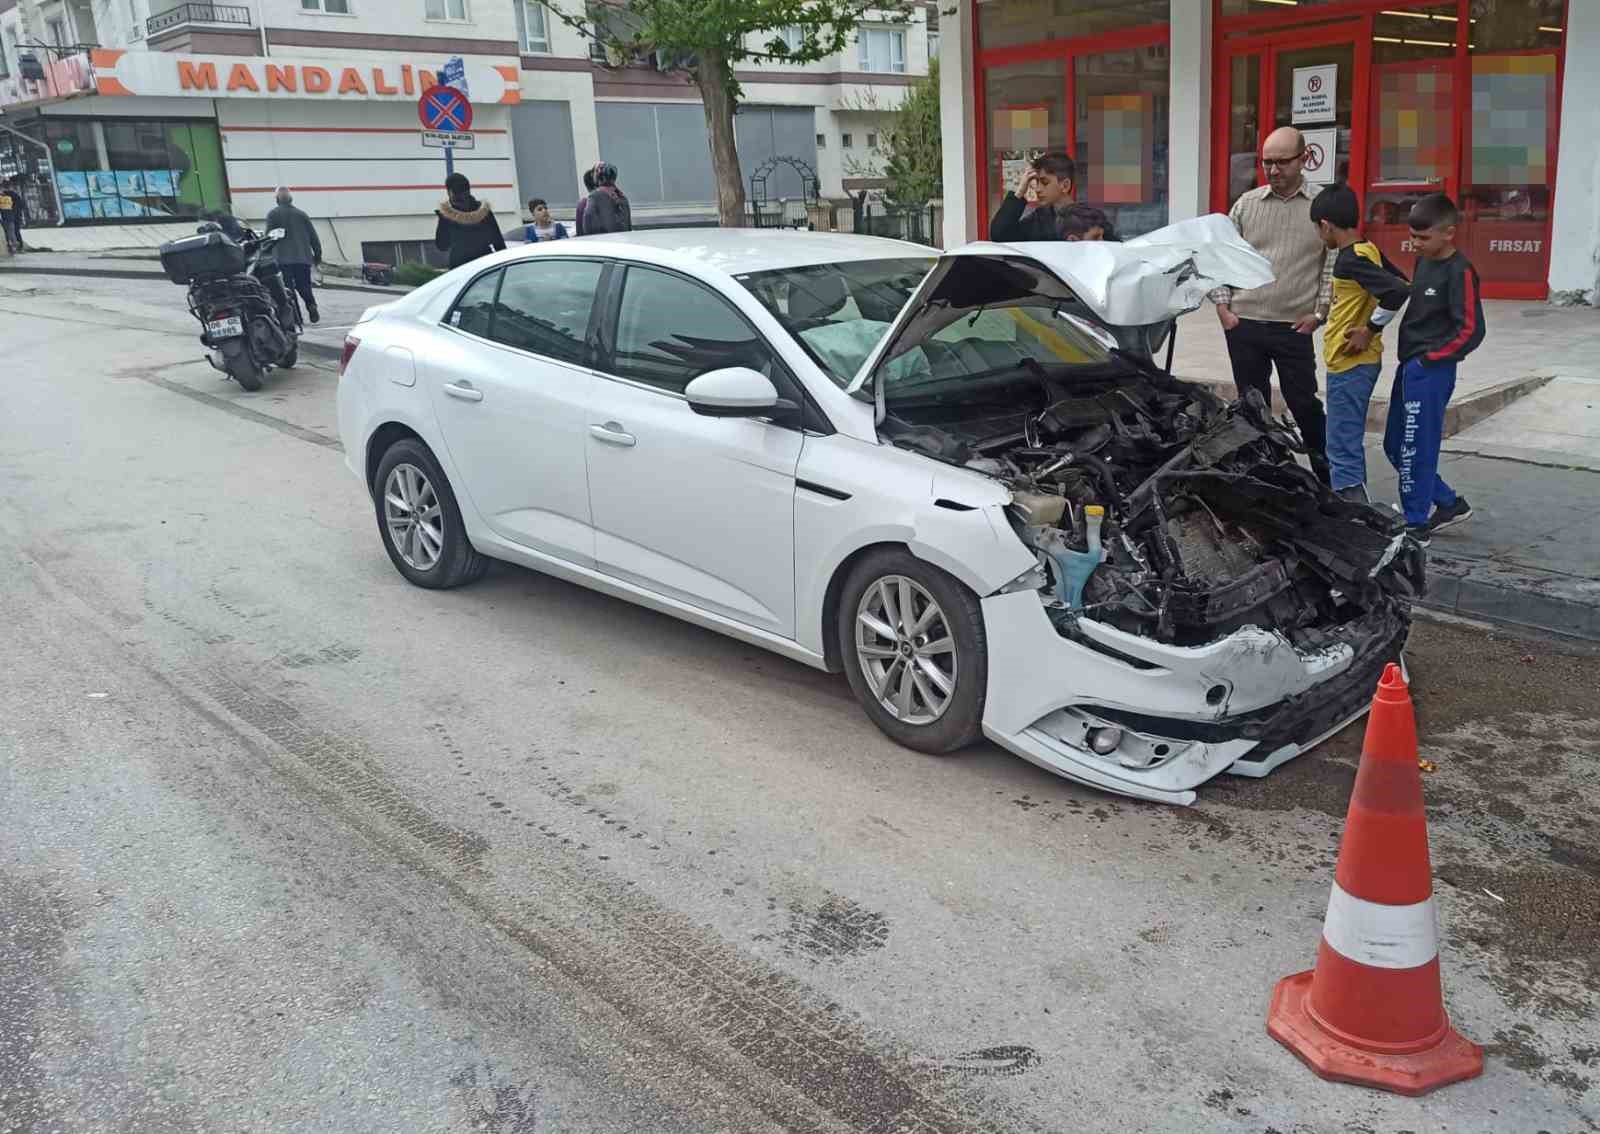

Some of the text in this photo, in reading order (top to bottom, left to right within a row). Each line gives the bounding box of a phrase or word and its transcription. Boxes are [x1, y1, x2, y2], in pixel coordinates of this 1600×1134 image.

[1488, 240, 1542, 253] FIRSAT
[1400, 401, 1421, 493] Palm Angels
